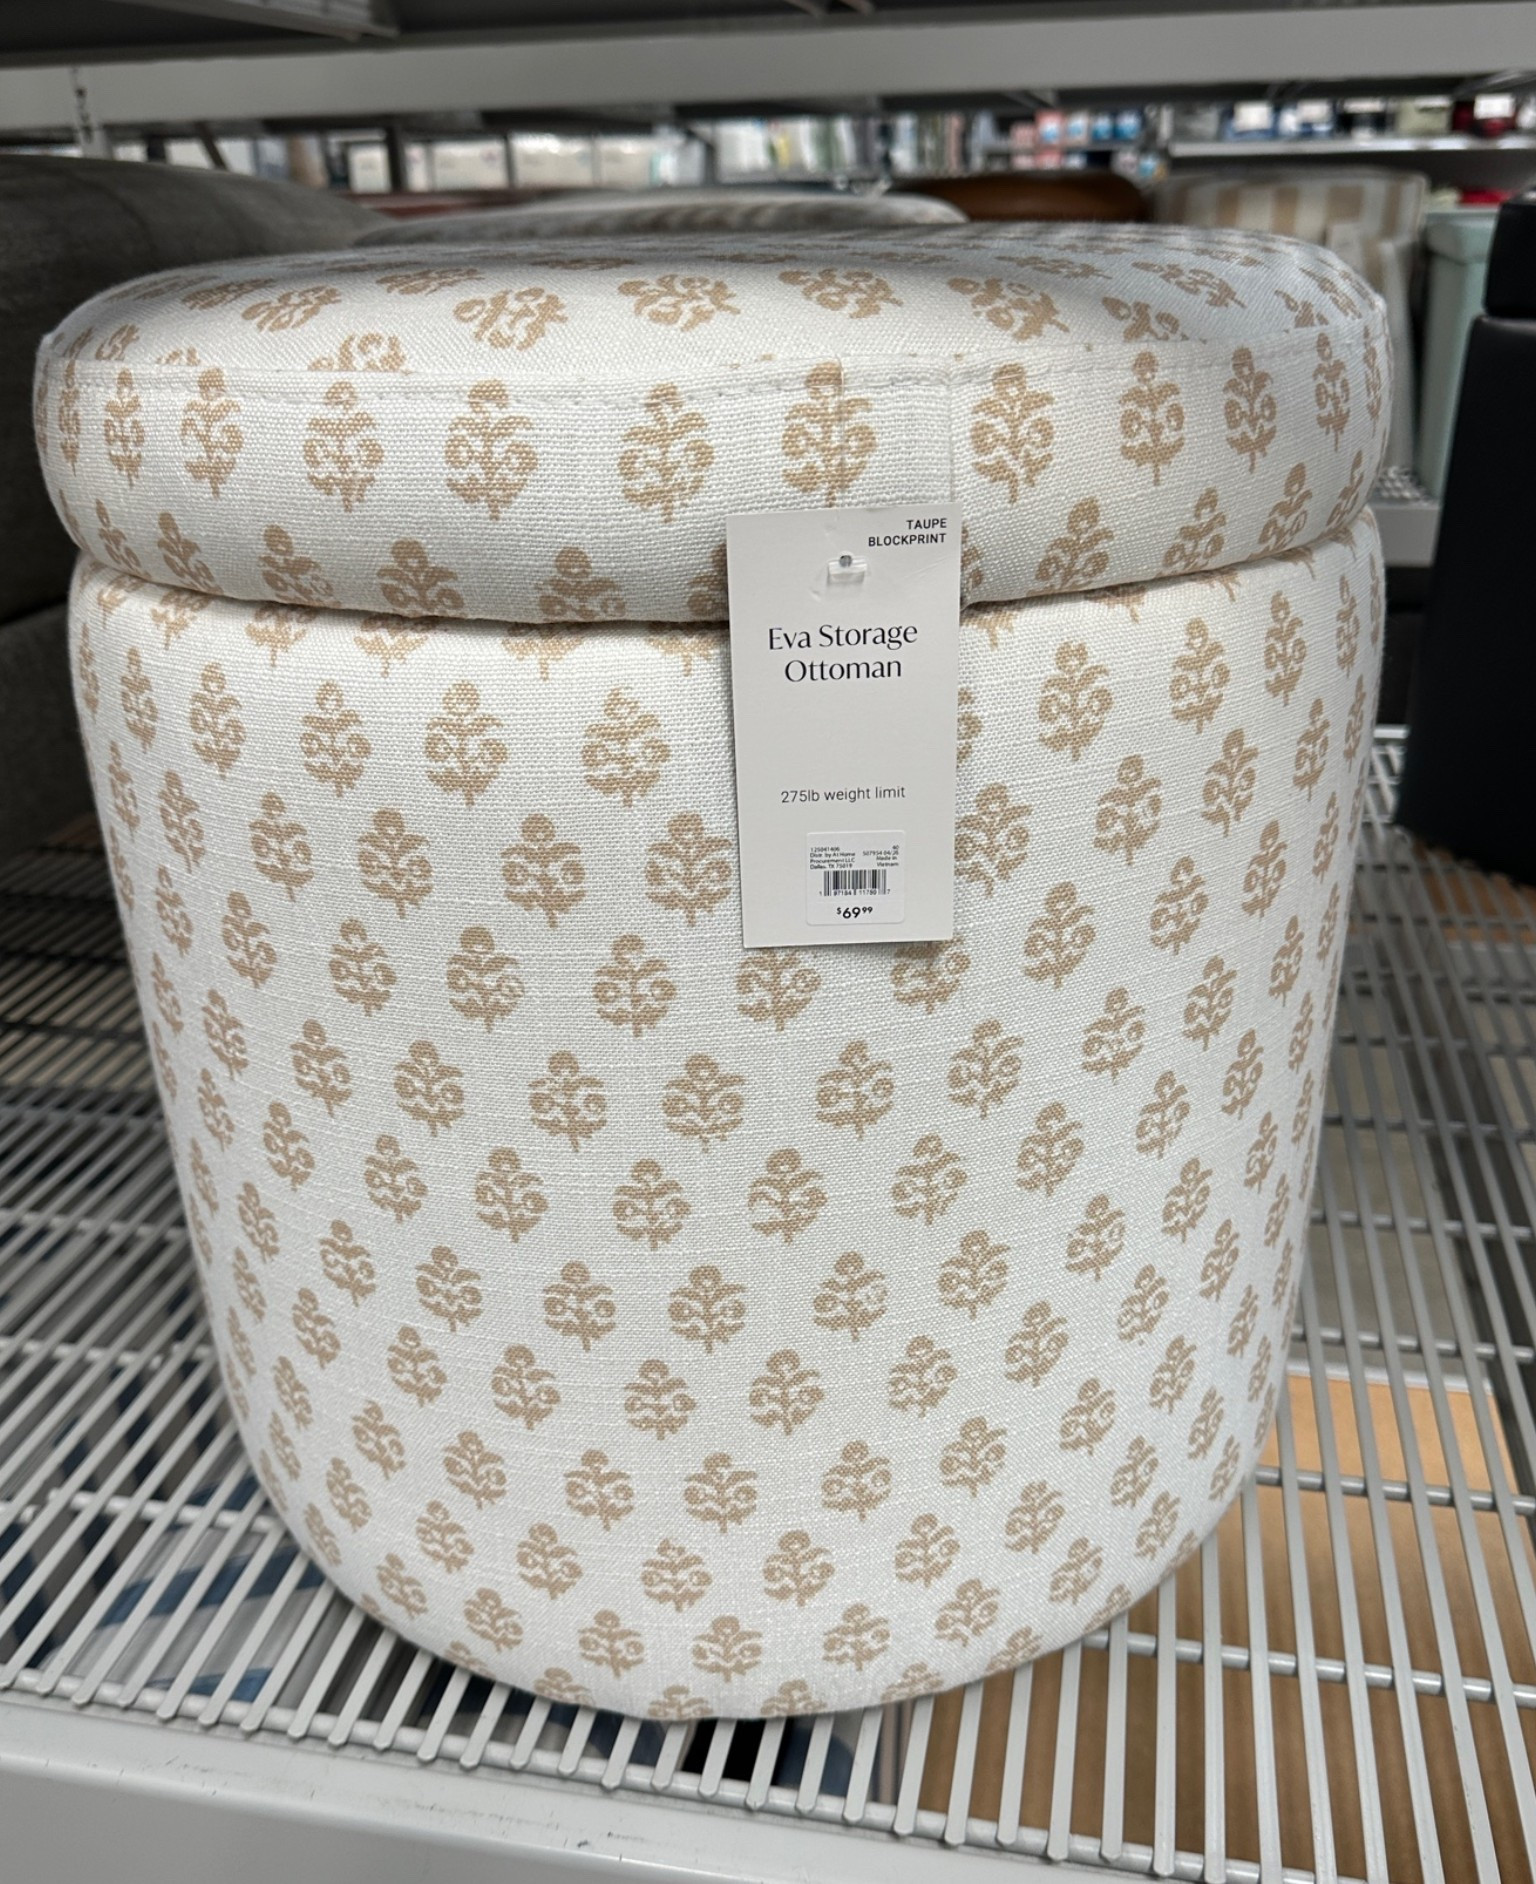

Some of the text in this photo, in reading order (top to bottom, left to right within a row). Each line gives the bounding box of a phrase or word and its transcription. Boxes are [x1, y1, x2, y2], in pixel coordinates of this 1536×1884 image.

[906, 518, 947, 530] TAUPE
[868, 533, 947, 547] BLOCKPRINT
[768, 624, 918, 651] Eva Storage
[784, 659, 902, 683] Ottoman
[781, 786, 906, 803] 275lb weight limit
